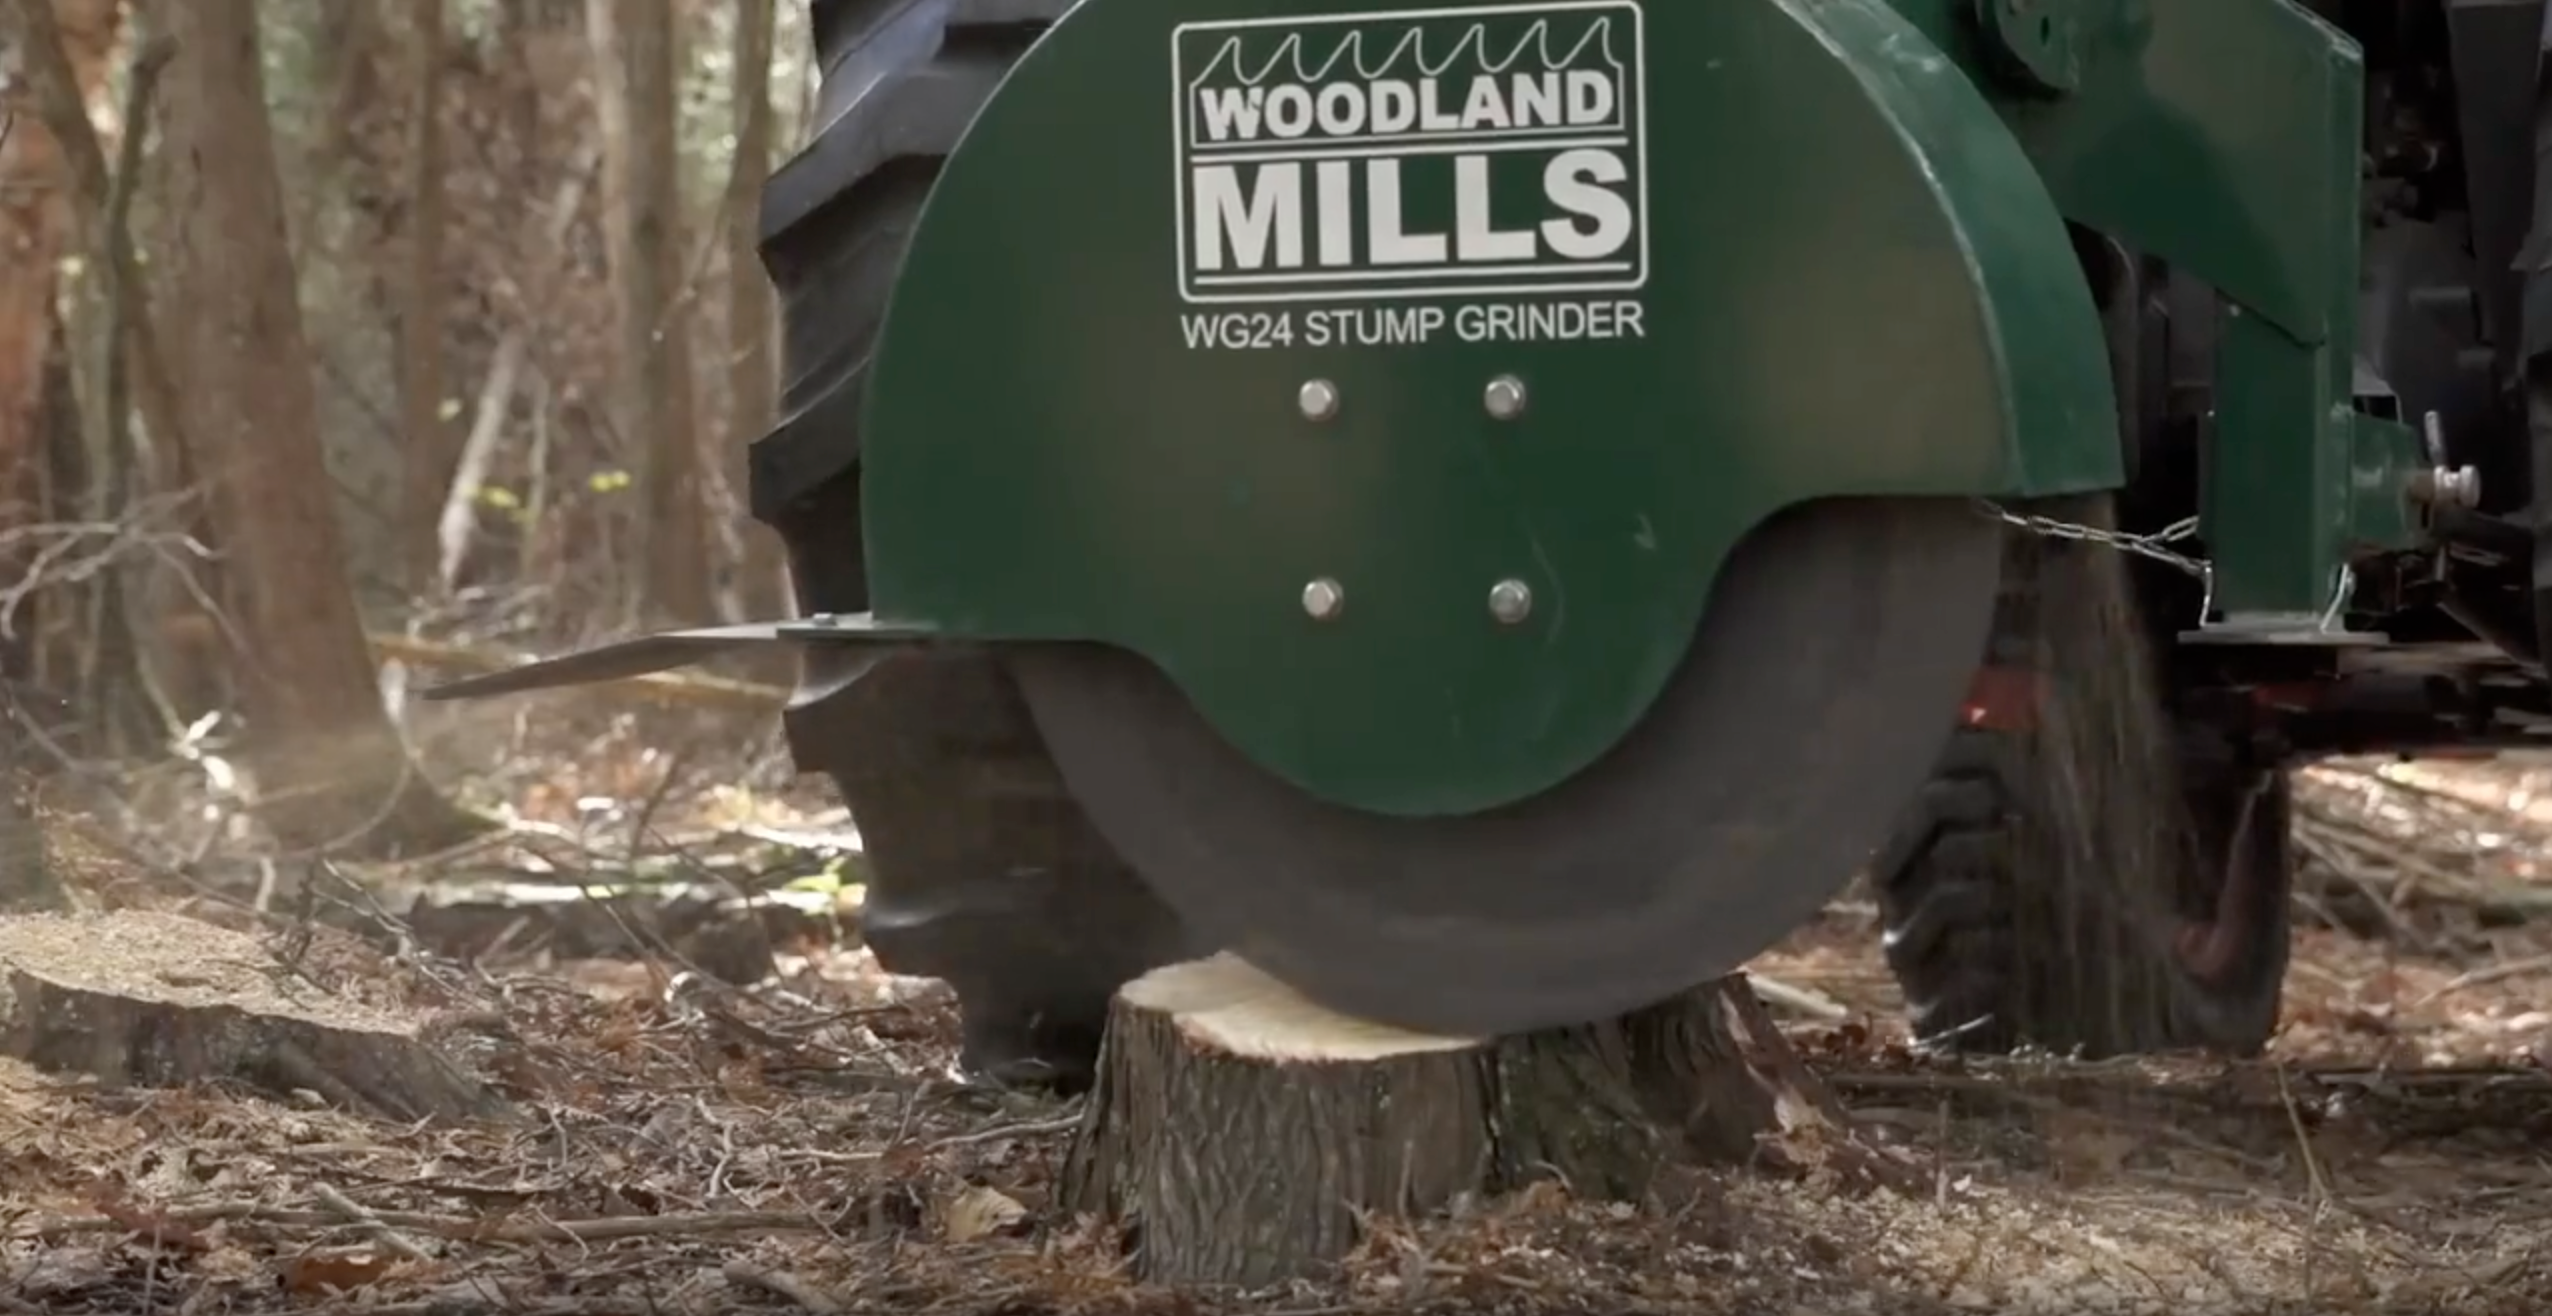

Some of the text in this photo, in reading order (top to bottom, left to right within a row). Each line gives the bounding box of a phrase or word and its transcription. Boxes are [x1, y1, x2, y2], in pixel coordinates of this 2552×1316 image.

[1200, 70, 1614, 141] WOODLAND
[1193, 148, 1633, 271] MILLS
[1181, 301, 1645, 349] WG24 STUMP GRINDER
